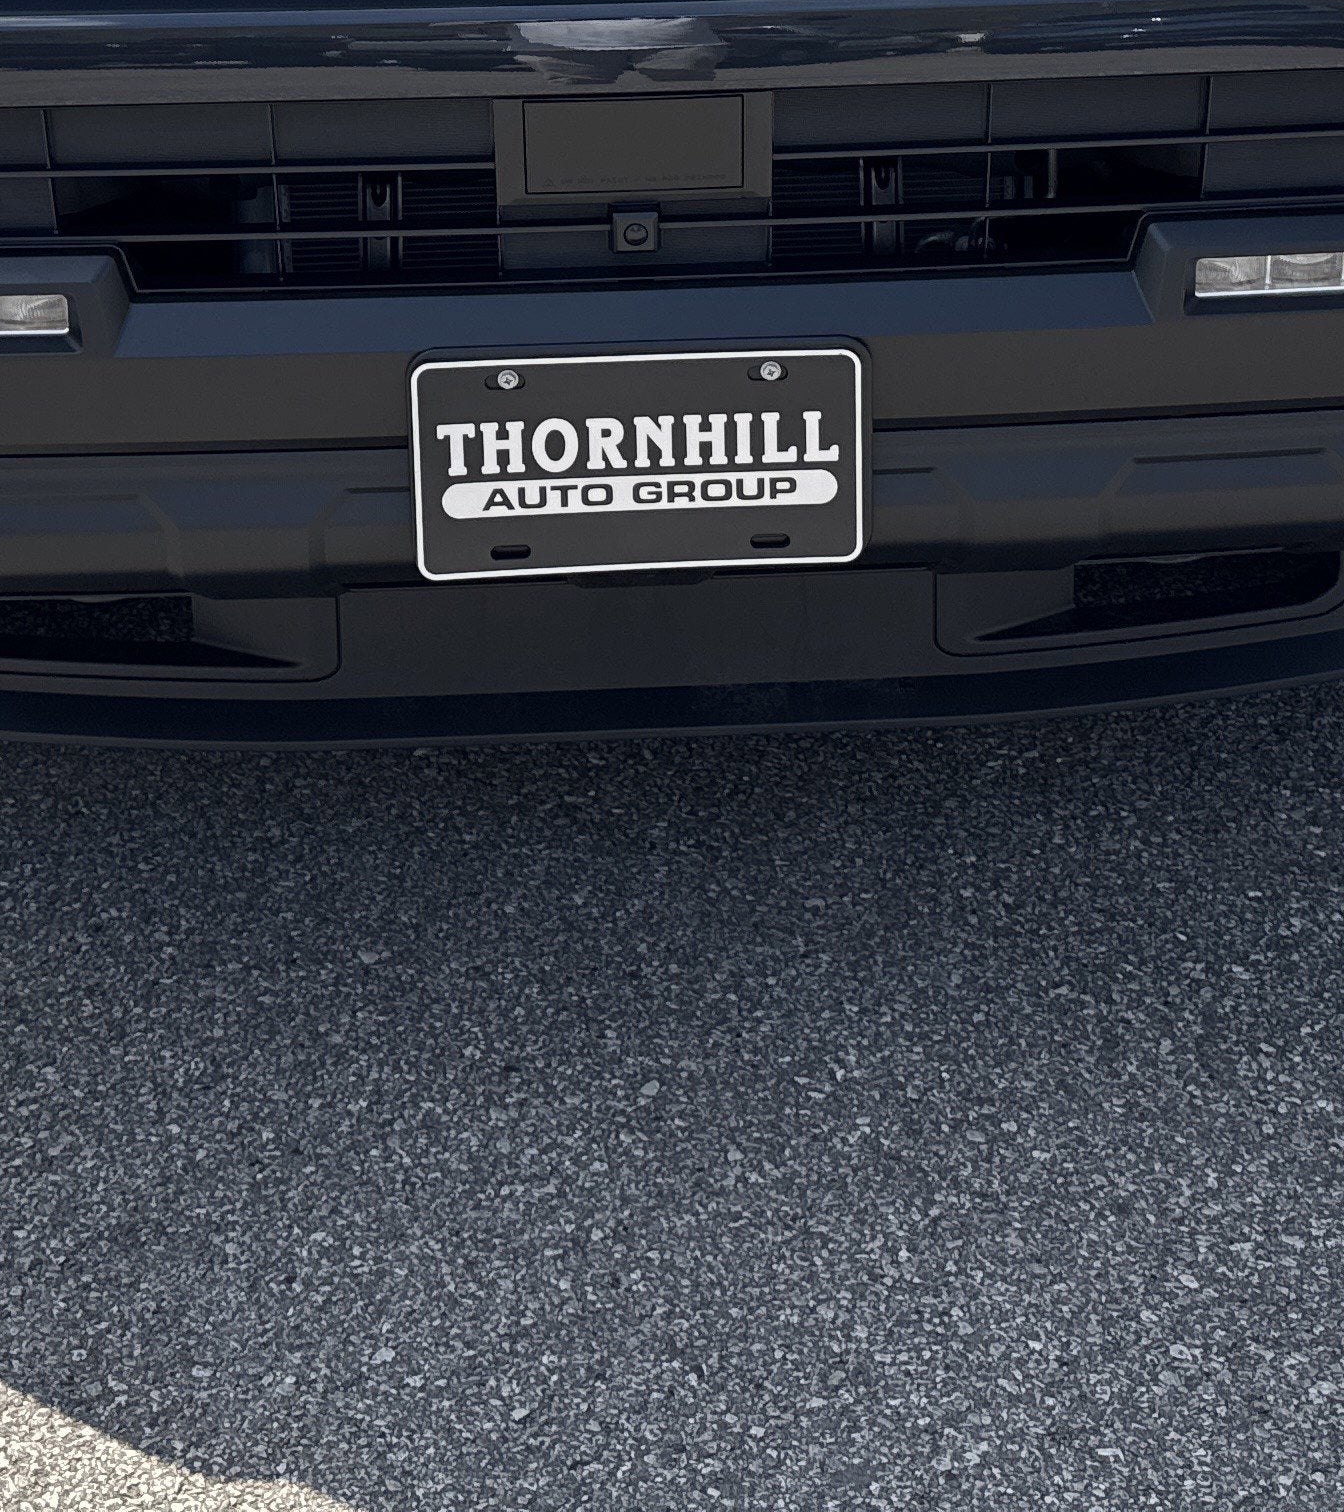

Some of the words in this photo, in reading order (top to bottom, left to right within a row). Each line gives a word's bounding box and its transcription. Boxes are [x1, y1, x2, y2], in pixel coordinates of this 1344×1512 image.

[436, 410, 839, 476] THORNHILL
[482, 483, 613, 512] AUTO
[632, 476, 797, 504] GROUP
